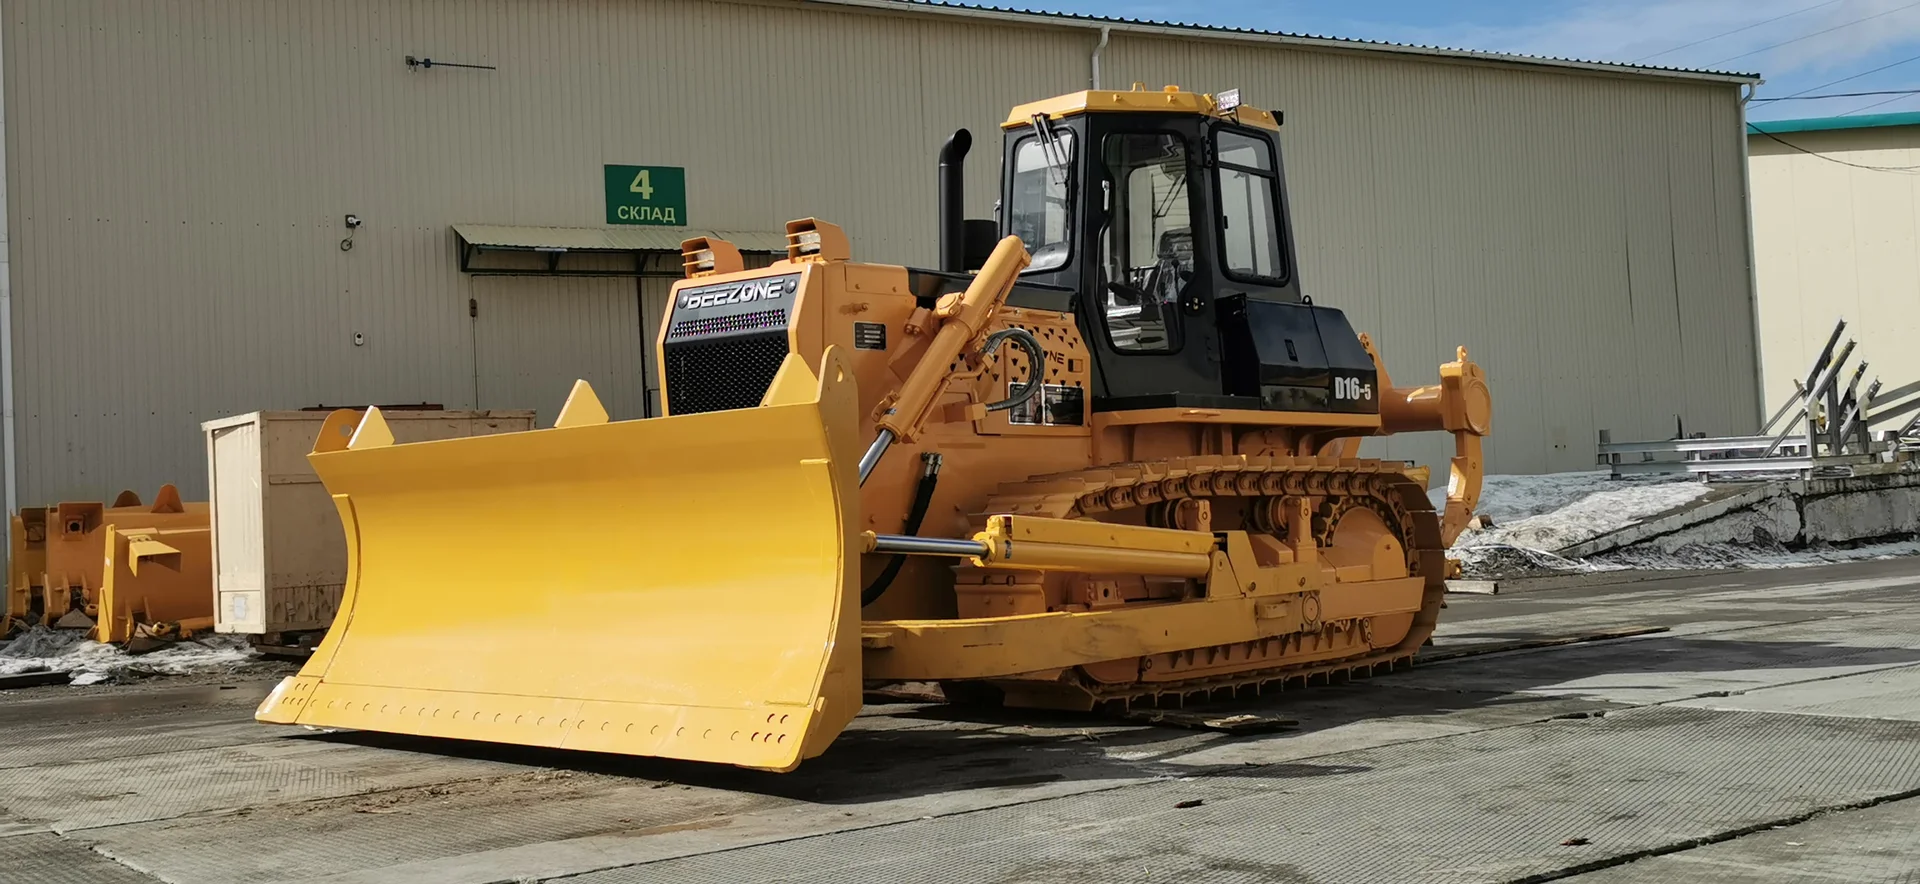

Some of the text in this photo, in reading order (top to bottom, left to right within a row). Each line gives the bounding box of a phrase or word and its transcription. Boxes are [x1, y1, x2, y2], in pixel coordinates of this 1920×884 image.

[629, 169, 654, 200] 4
[617, 205, 676, 224] СКЛАД
[687, 278, 785, 310] BEEZONE
[1334, 376, 1372, 401] D16-5
